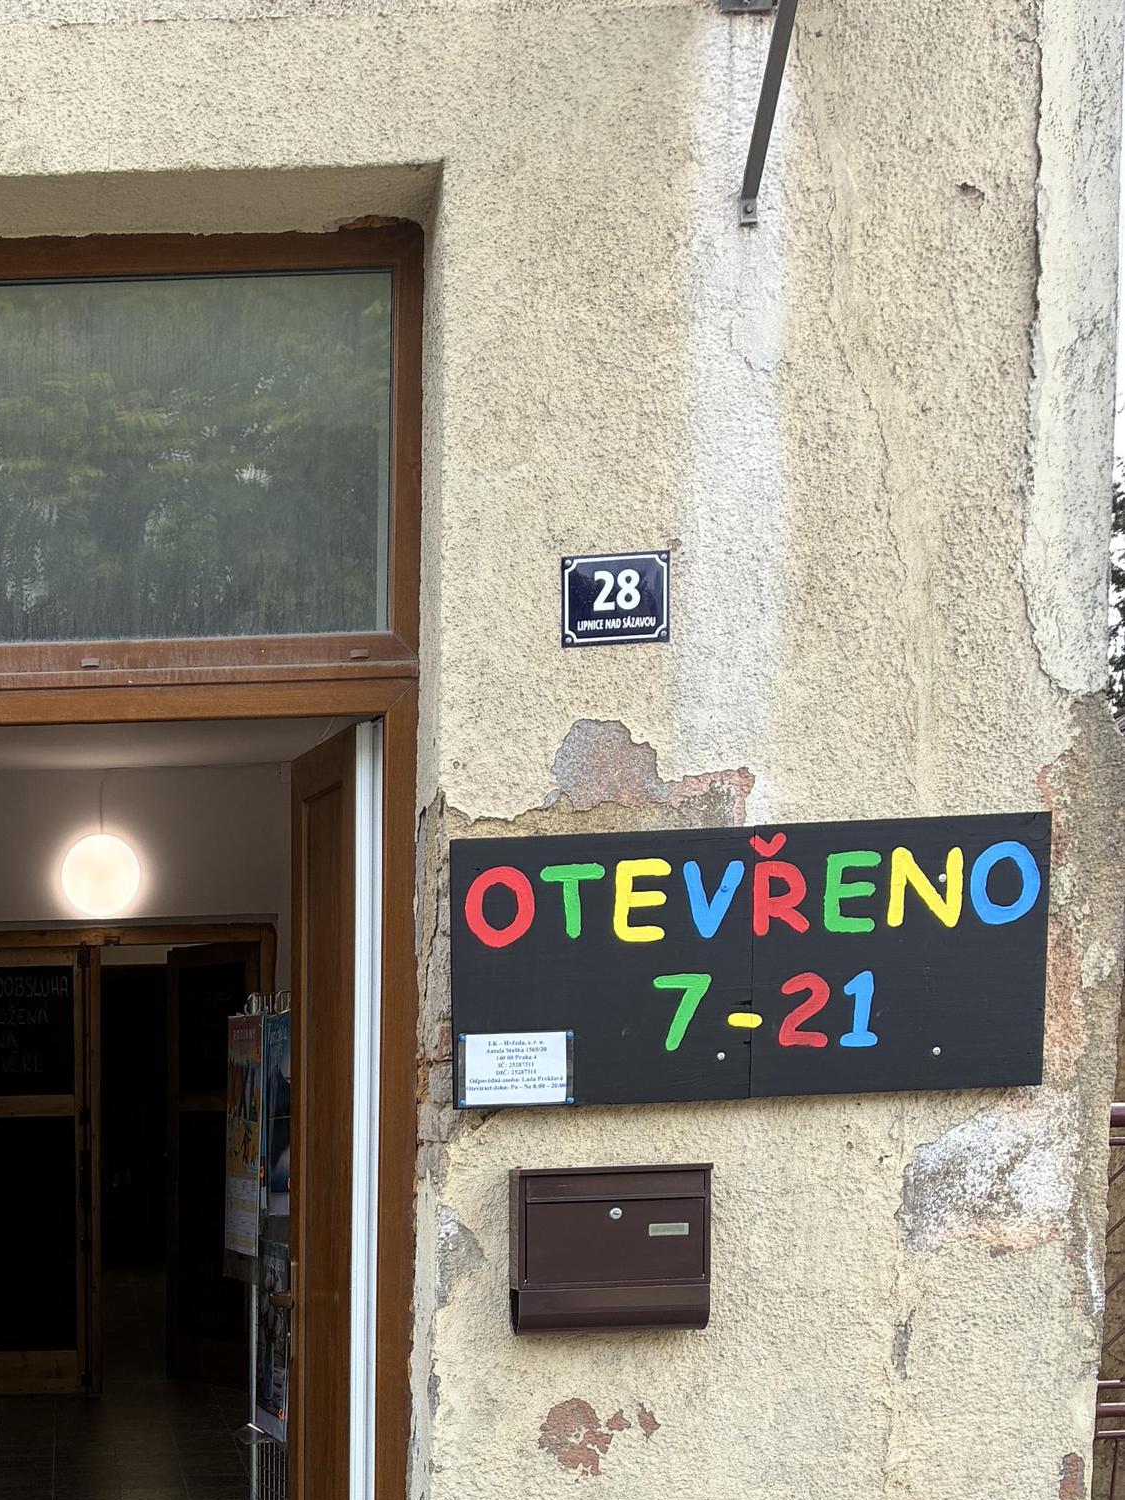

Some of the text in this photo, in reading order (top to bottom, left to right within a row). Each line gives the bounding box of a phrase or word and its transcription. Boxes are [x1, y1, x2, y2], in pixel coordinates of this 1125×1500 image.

[593, 568, 641, 612] 28
[577, 615, 656, 632] LIPNICE NAD SÁZAVOU
[464, 831, 1042, 949] OTEVŘENO
